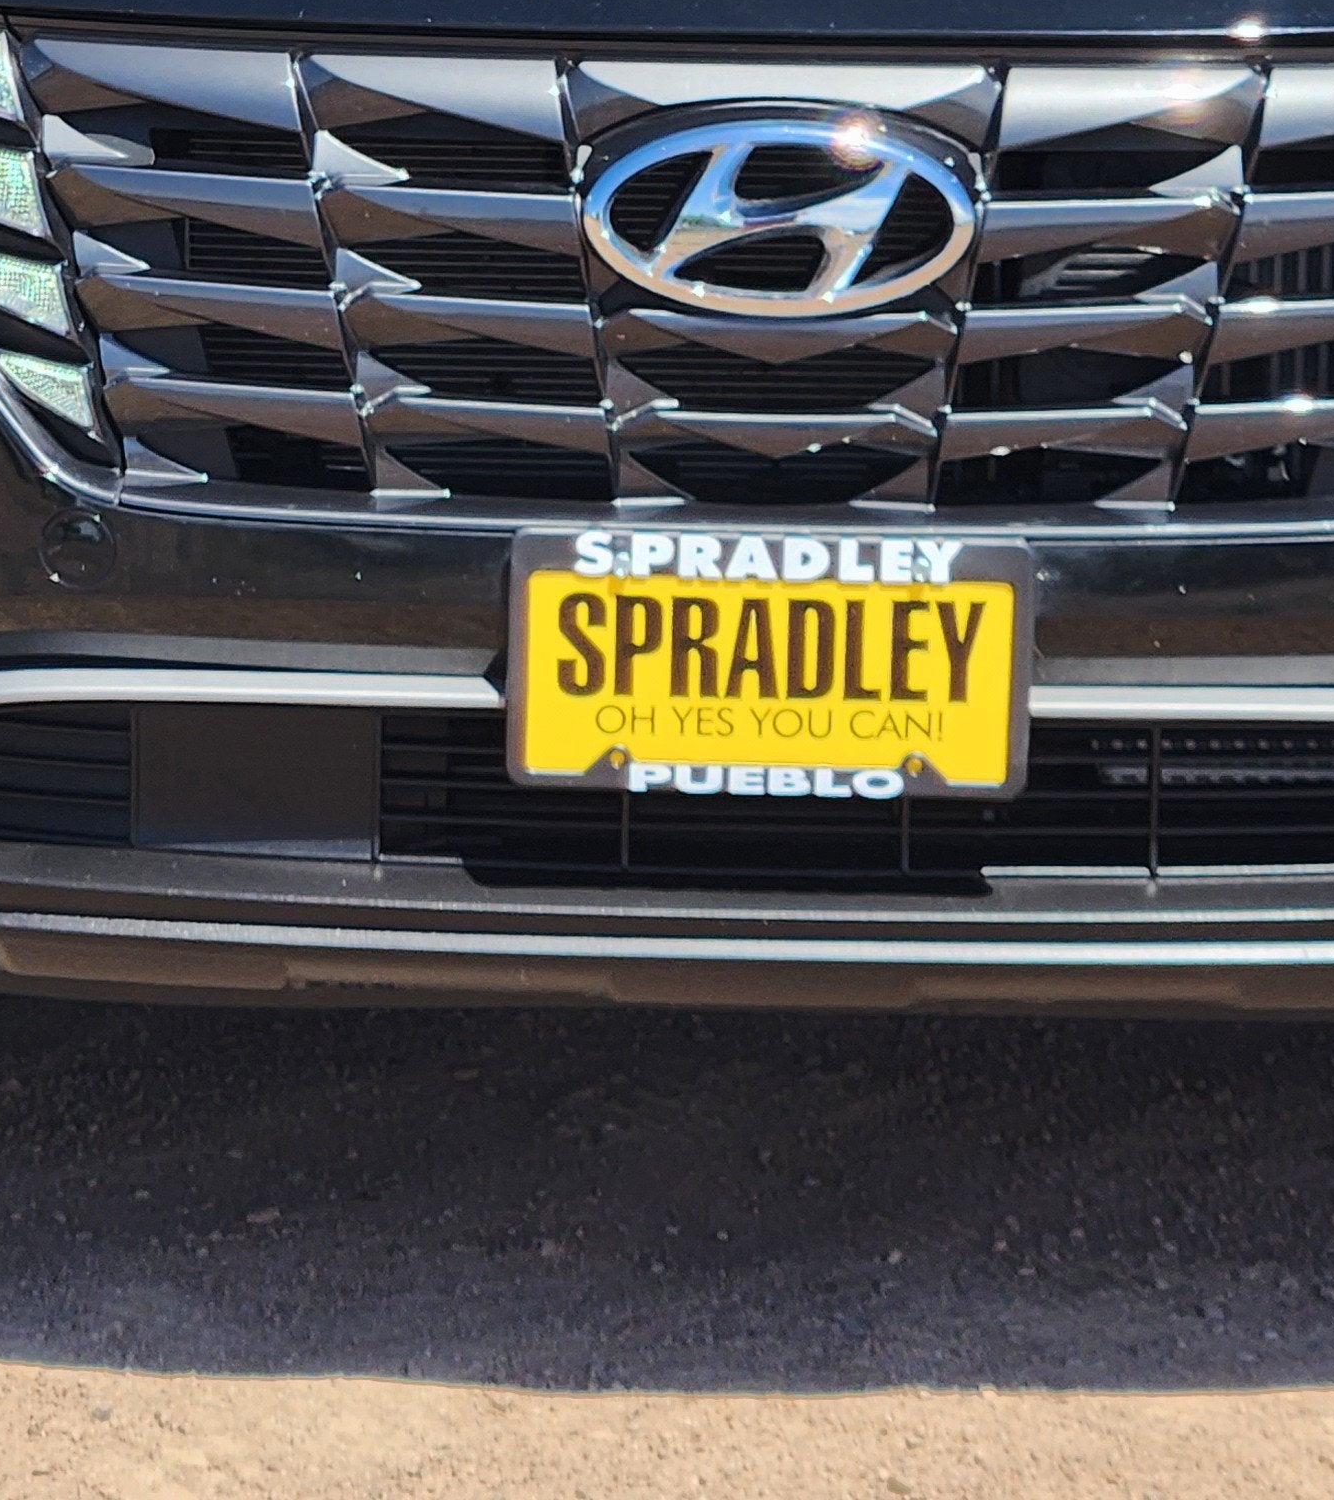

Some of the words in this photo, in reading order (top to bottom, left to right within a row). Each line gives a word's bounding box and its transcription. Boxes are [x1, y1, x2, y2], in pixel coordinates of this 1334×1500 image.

[574, 528, 964, 585] SPRADLEY
[557, 591, 988, 703] SPRADLEY
[595, 704, 657, 736] OH
[670, 705, 735, 737] YES
[749, 707, 833, 739] YOU
[848, 709, 945, 743] CAN!
[627, 761, 906, 800] PUEBLO
